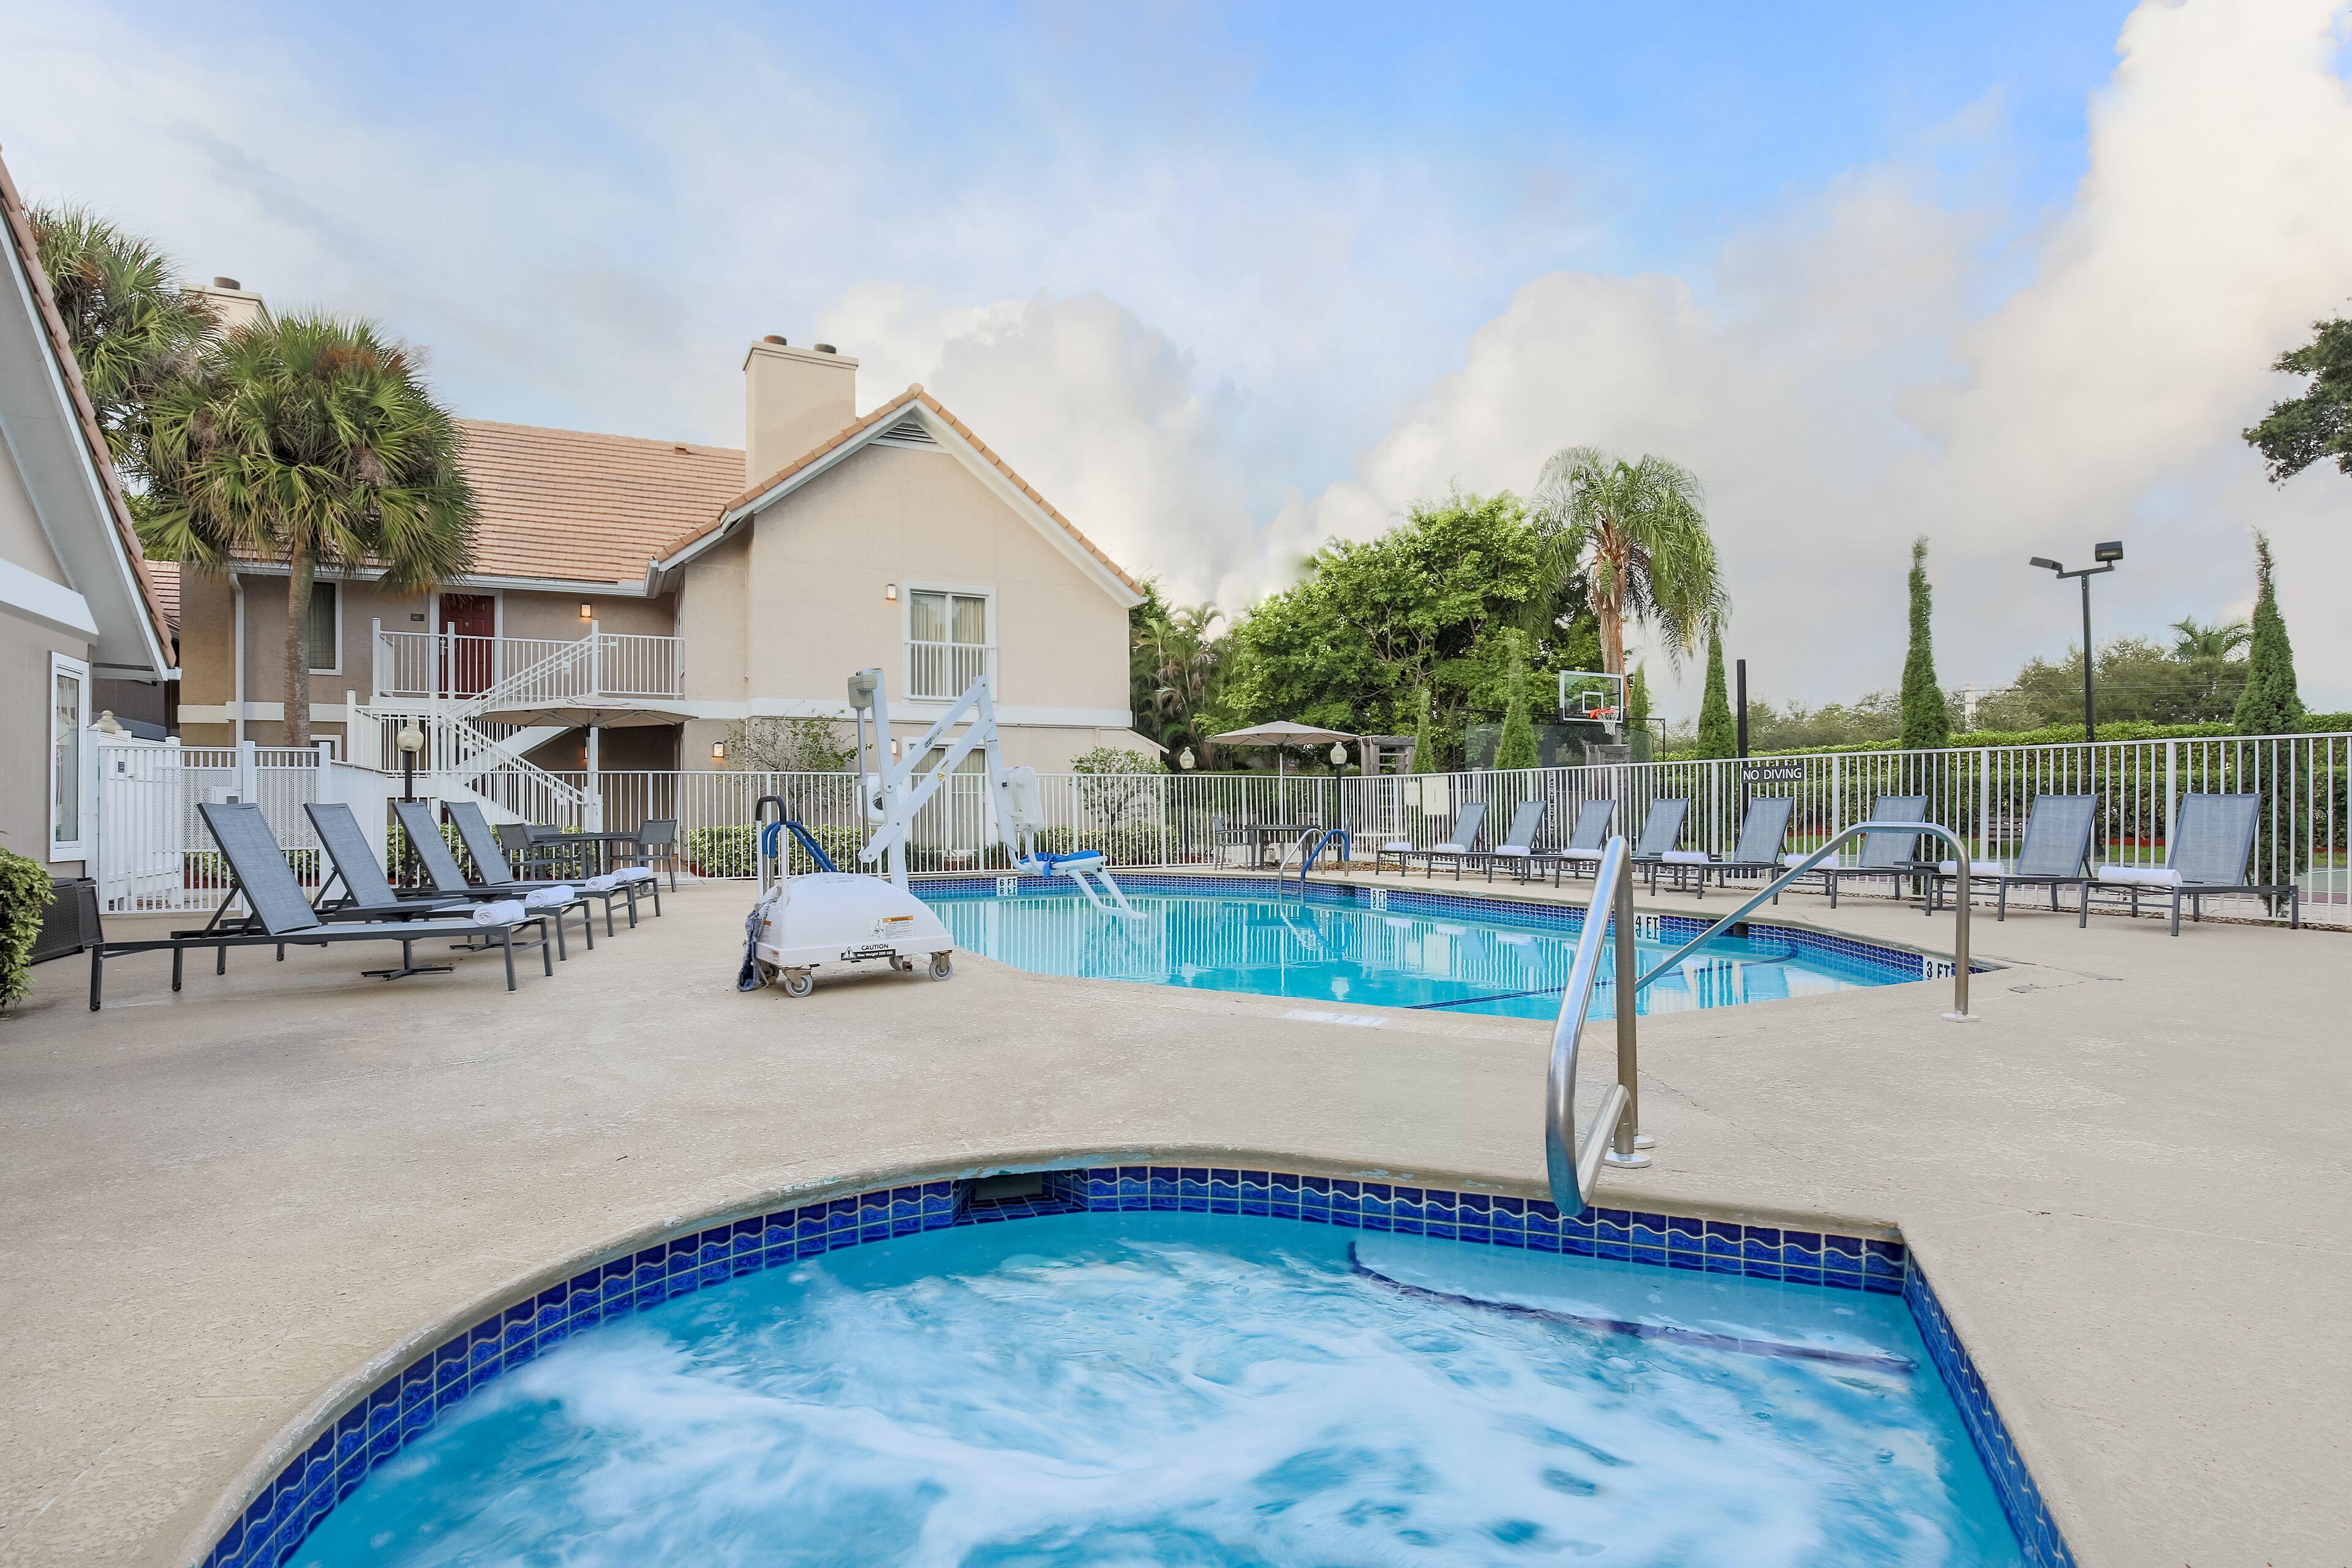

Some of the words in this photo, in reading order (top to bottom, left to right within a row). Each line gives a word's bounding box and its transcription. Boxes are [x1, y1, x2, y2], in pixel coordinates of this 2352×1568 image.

[1743, 769, 1760, 780] NO
[1763, 768, 1802, 779] DIVING
[1373, 890, 1376, 899] 5
[1635, 916, 1642, 927] 4
[1926, 961, 1932, 978] 3
[1937, 963, 1950, 979] FT
[1348, 1016, 1386, 1026] FT
